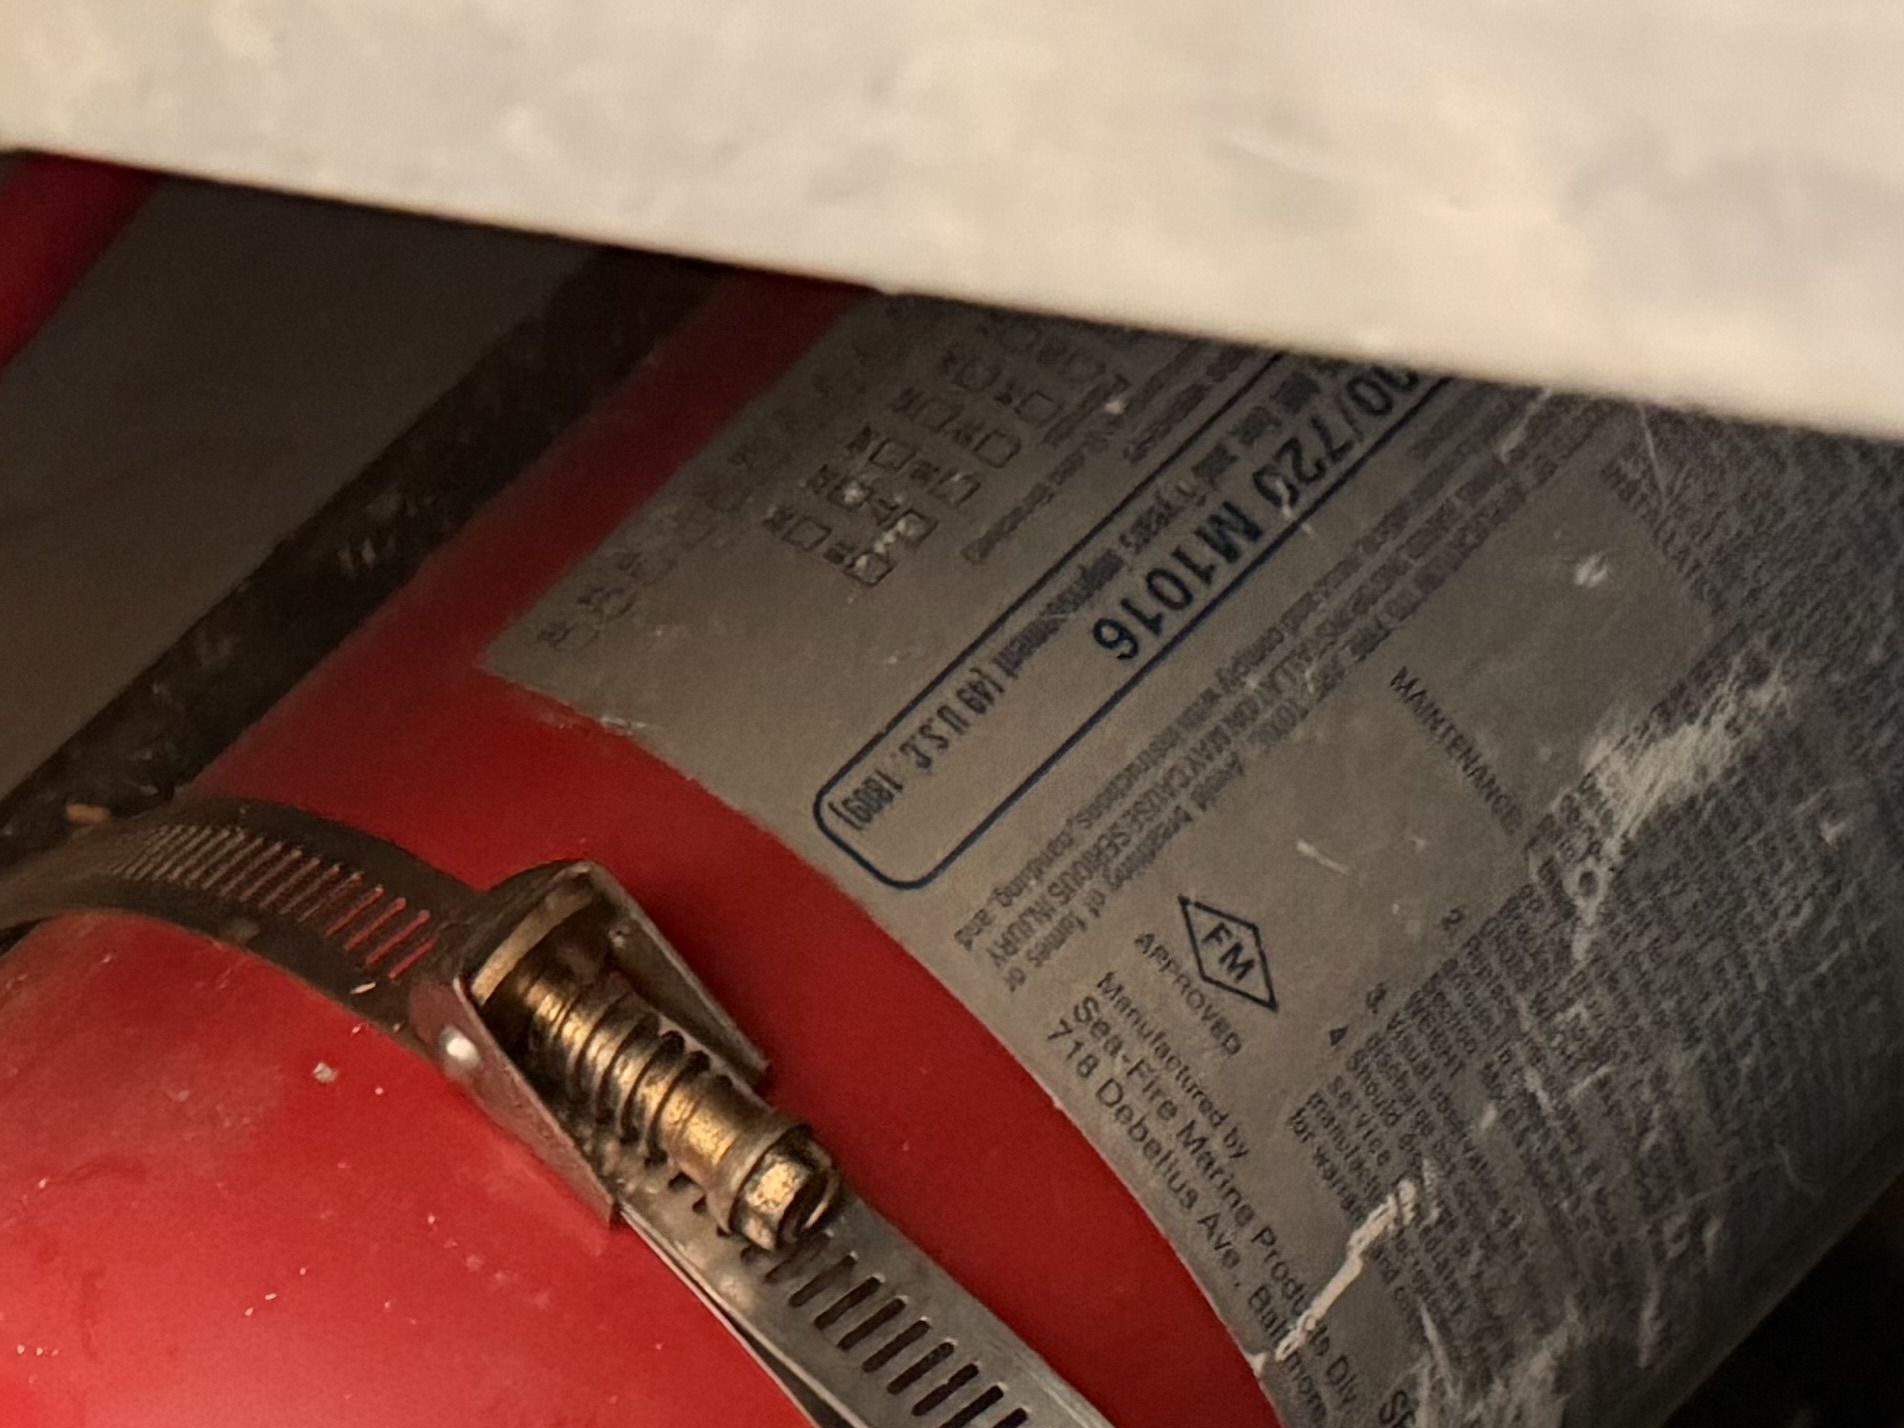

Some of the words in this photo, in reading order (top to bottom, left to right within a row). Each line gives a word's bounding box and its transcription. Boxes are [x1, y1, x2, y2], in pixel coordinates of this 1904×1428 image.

[1086, 499, 1265, 666] M1016
[826, 768, 904, 831] 1809)
[1118, 764, 1193, 835] CAUSE
[1044, 821, 1133, 906] SERIOUS
[983, 894, 1058, 968] INJURY
[1200, 919, 1256, 985] FM
[1133, 932, 1242, 1057] APPROVED
[1096, 969, 1231, 1129] Manufactured
[1221, 1122, 1252, 1158] by
[1343, 1047, 1404, 1129] Should
[1047, 1017, 1101, 1080] 718
[1094, 1076, 1202, 1211] Debelius
[1070, 994, 1182, 1122] Sea-Fire
[1174, 1119, 1258, 1229] Marine
[1324, 1073, 1395, 1168] service
